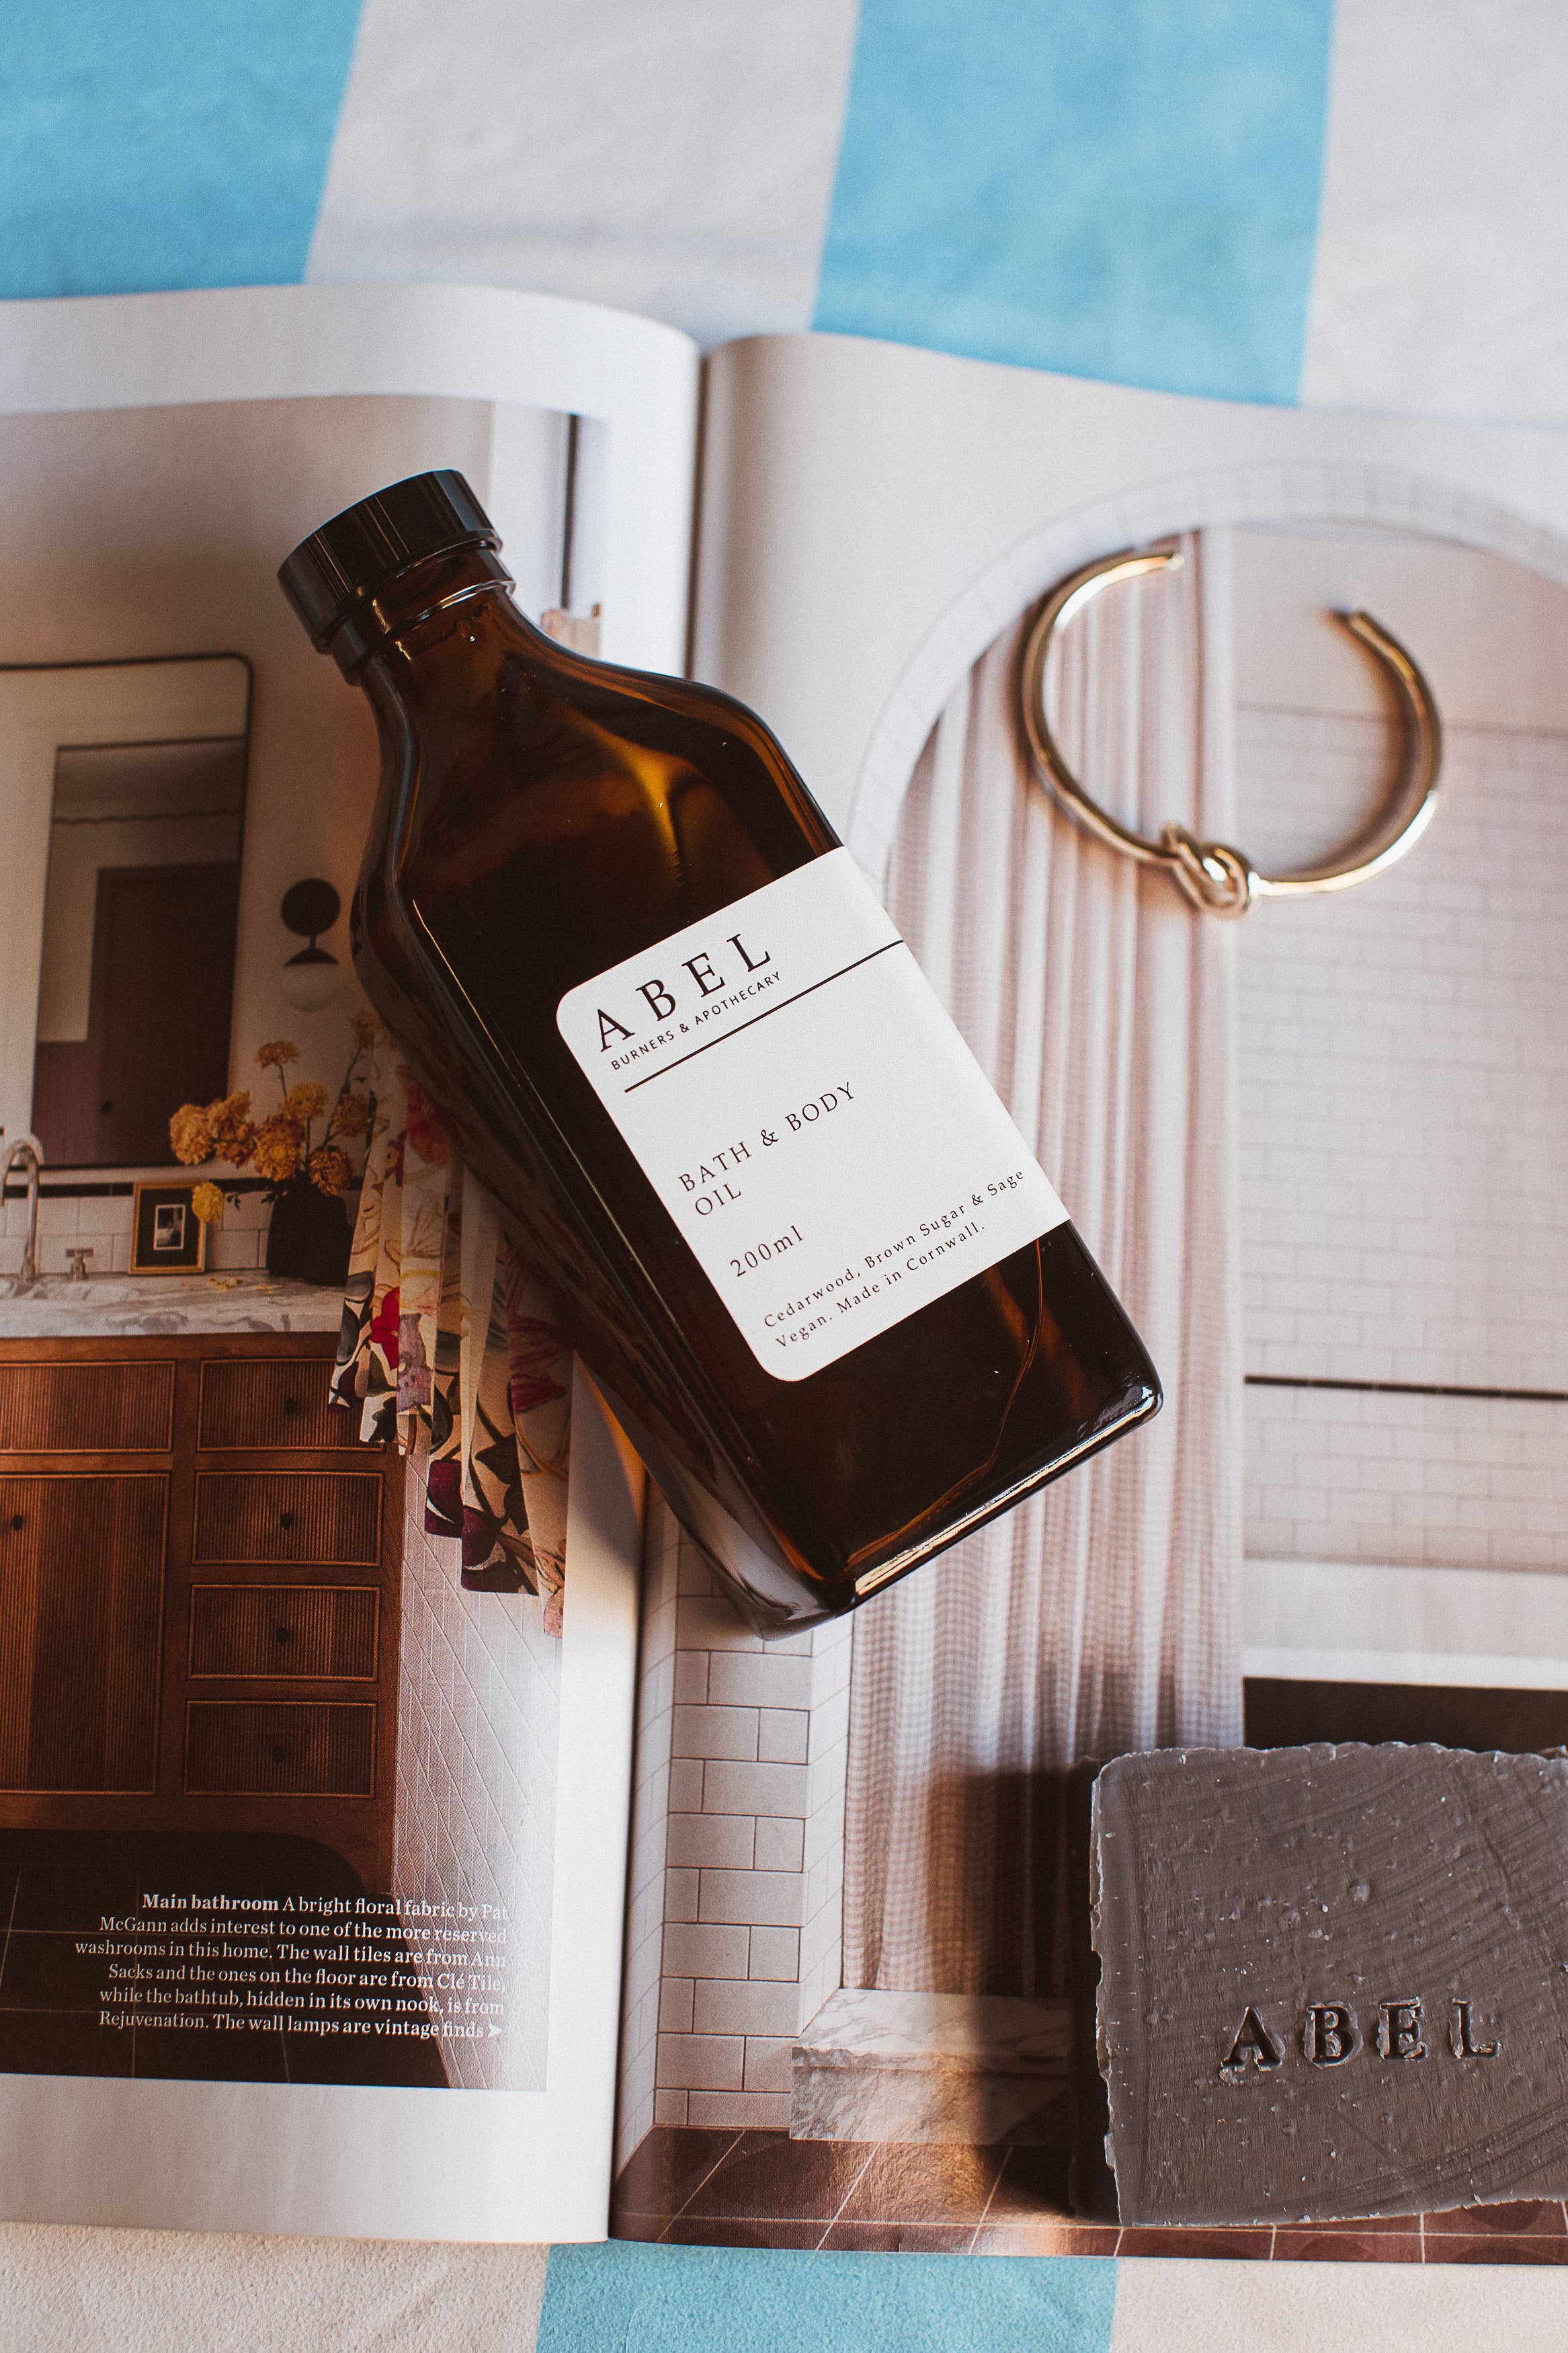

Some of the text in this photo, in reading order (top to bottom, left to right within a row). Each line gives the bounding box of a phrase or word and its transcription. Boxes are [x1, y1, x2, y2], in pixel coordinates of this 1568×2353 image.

[597, 933, 771, 1053] ABEL
[611, 971, 781, 1070] BURNERS & APOTHECARY
[677, 1082, 854, 1192] BATH & BODY
[695, 1183, 741, 1215] OIL
[730, 1225, 804, 1277] 200ml
[764, 1171, 1024, 1328] Cedarwood, Brown Sugar & Sage
[775, 1222, 985, 1348] Vegan. Made in Cornwall.
[142, 1893, 187, 1909] Main
[192, 1895, 279, 1911] bathroom
[282, 1897, 295, 1912] A
[299, 1897, 351, 1916] bright
[356, 1897, 401, 1915] floral
[404, 1899, 456, 1917] fabric
[457, 1901, 478, 1923] by
[99, 1916, 507, 1944] McGann adds interest to one of the more reserved
[75, 1940, 505, 1967] washrooms in this home. The wall tiles are from Ann
[109, 1964, 153, 1979] Sacks
[157, 1965, 185, 1981] and
[190, 1966, 215, 1981] the
[218, 1970, 256, 1983] ones
[259, 1971, 280, 1983] on
[285, 1968, 311, 1983] the
[316, 1968, 356, 1985] floor
[360, 1972, 387, 1986] are
[392, 1971, 434, 1989] from
[437, 1973, 465, 1990] Clé
[99, 1987, 504, 2015] while the bathtub, hidden in its own nook, is from
[99, 2011, 483, 2040] Rejuvenation. The wall lamps are vintage finds
[1221, 1997, 1501, 2072] ABEL
